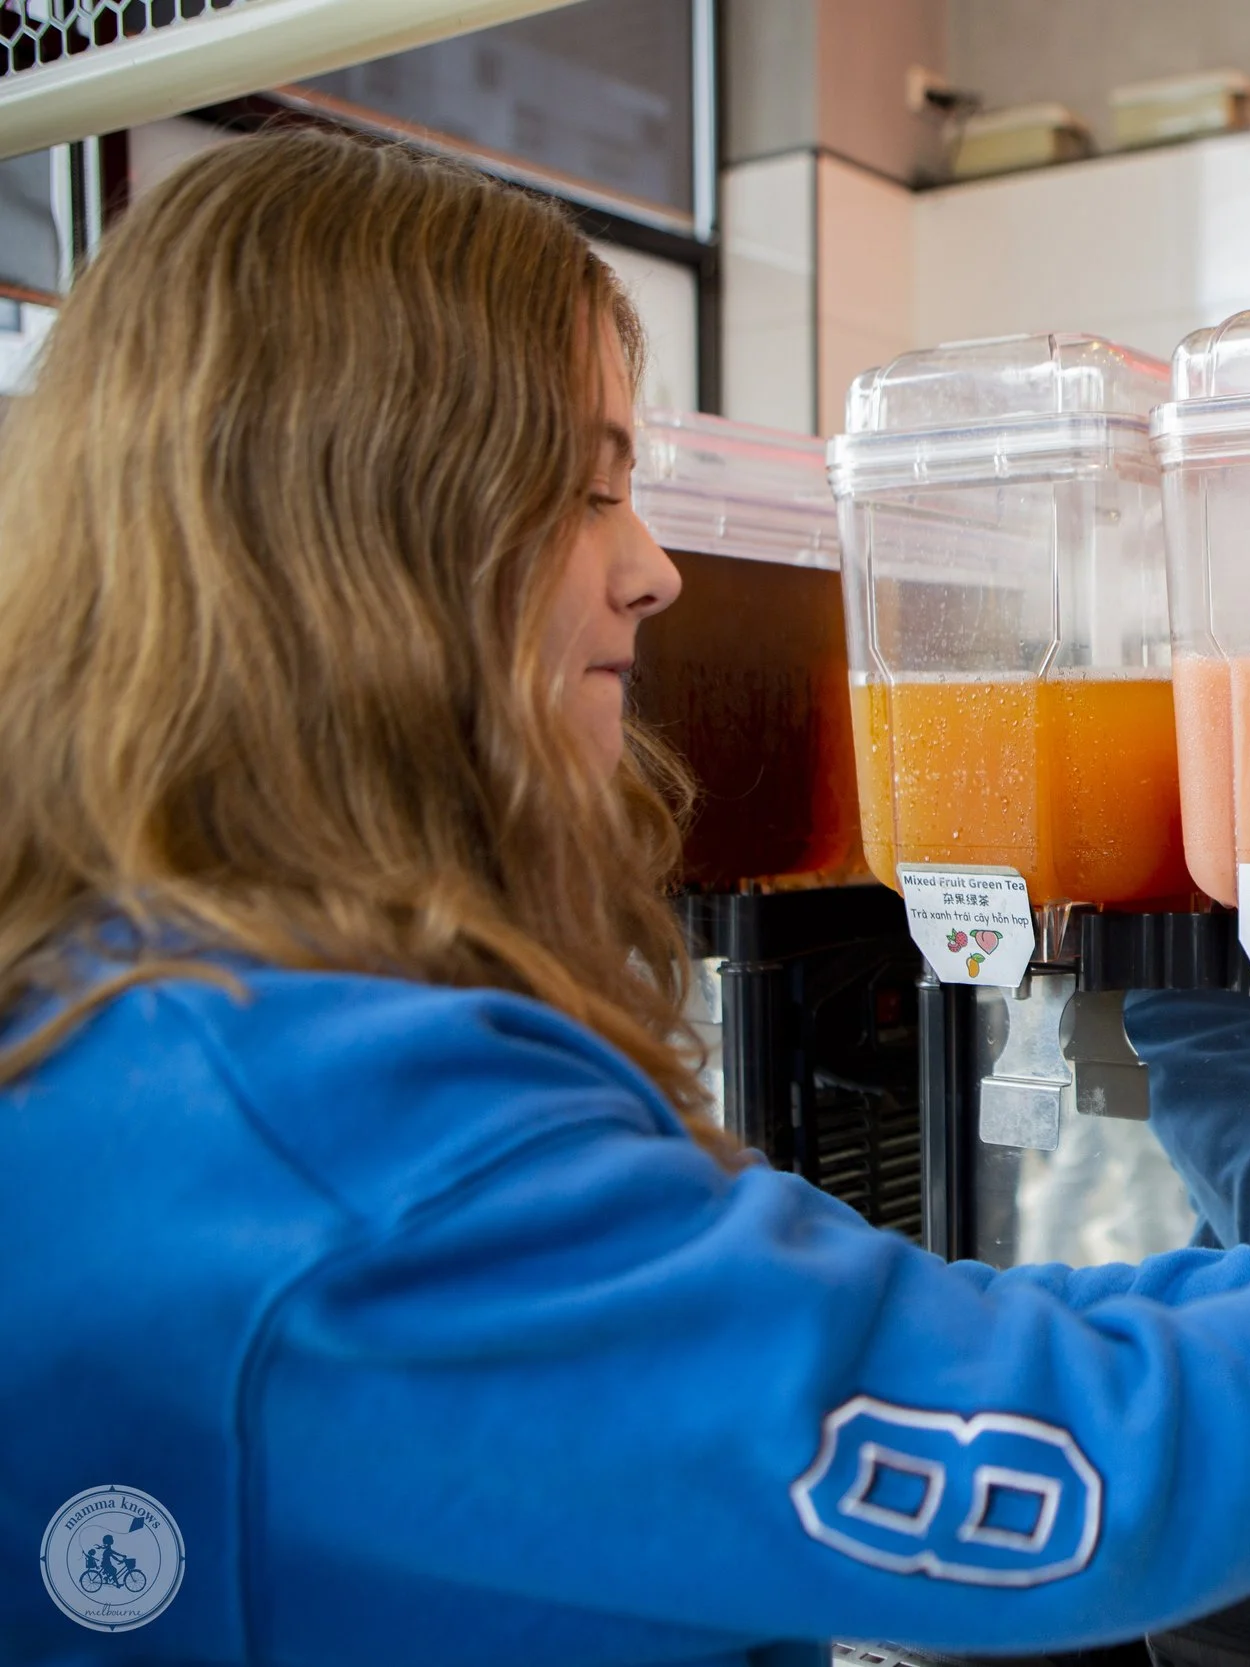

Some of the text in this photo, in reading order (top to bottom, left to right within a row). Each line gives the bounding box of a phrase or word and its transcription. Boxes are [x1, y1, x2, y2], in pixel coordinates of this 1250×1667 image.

[904, 875, 1025, 891] Mixed Fruit Green Tea
[943, 892, 990, 907] 杂果绿茶
[911, 908, 927, 919] Trà
[930, 910, 952, 921] xanh
[954, 911, 971, 922] trái
[974, 912, 990, 926] cây
[1012, 915, 1029, 928] hợp
[789, 1393, 1103, 1588] 8
